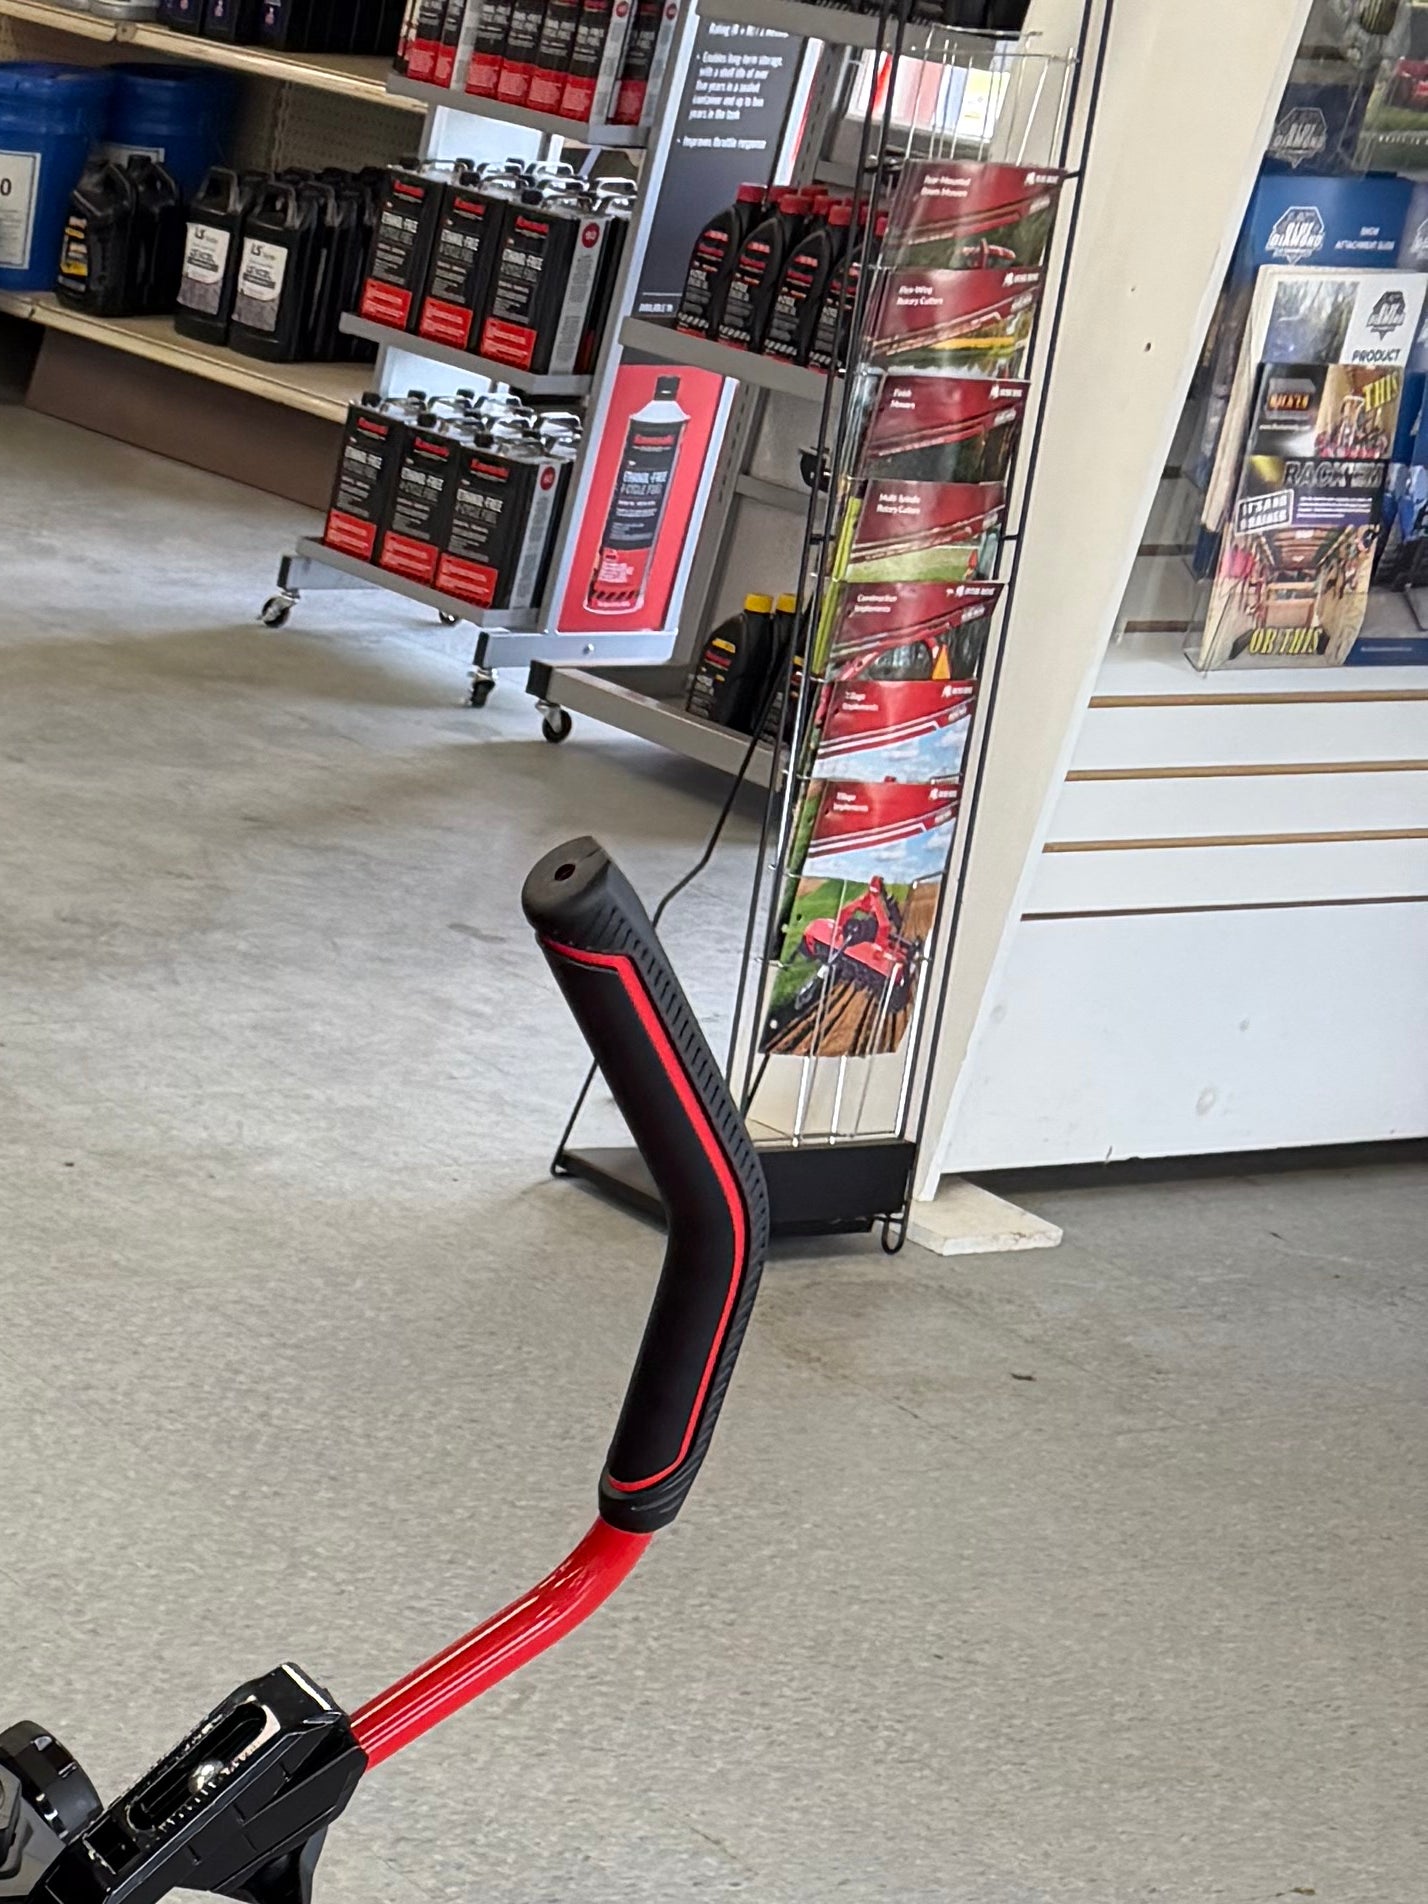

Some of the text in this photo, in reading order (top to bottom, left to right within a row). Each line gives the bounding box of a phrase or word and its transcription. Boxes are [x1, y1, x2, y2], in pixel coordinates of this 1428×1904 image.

[1352, 349, 1400, 362] PRODUCT
[1363, 373, 1398, 412] THIS
[1249, 626, 1324, 656] OR THIS
